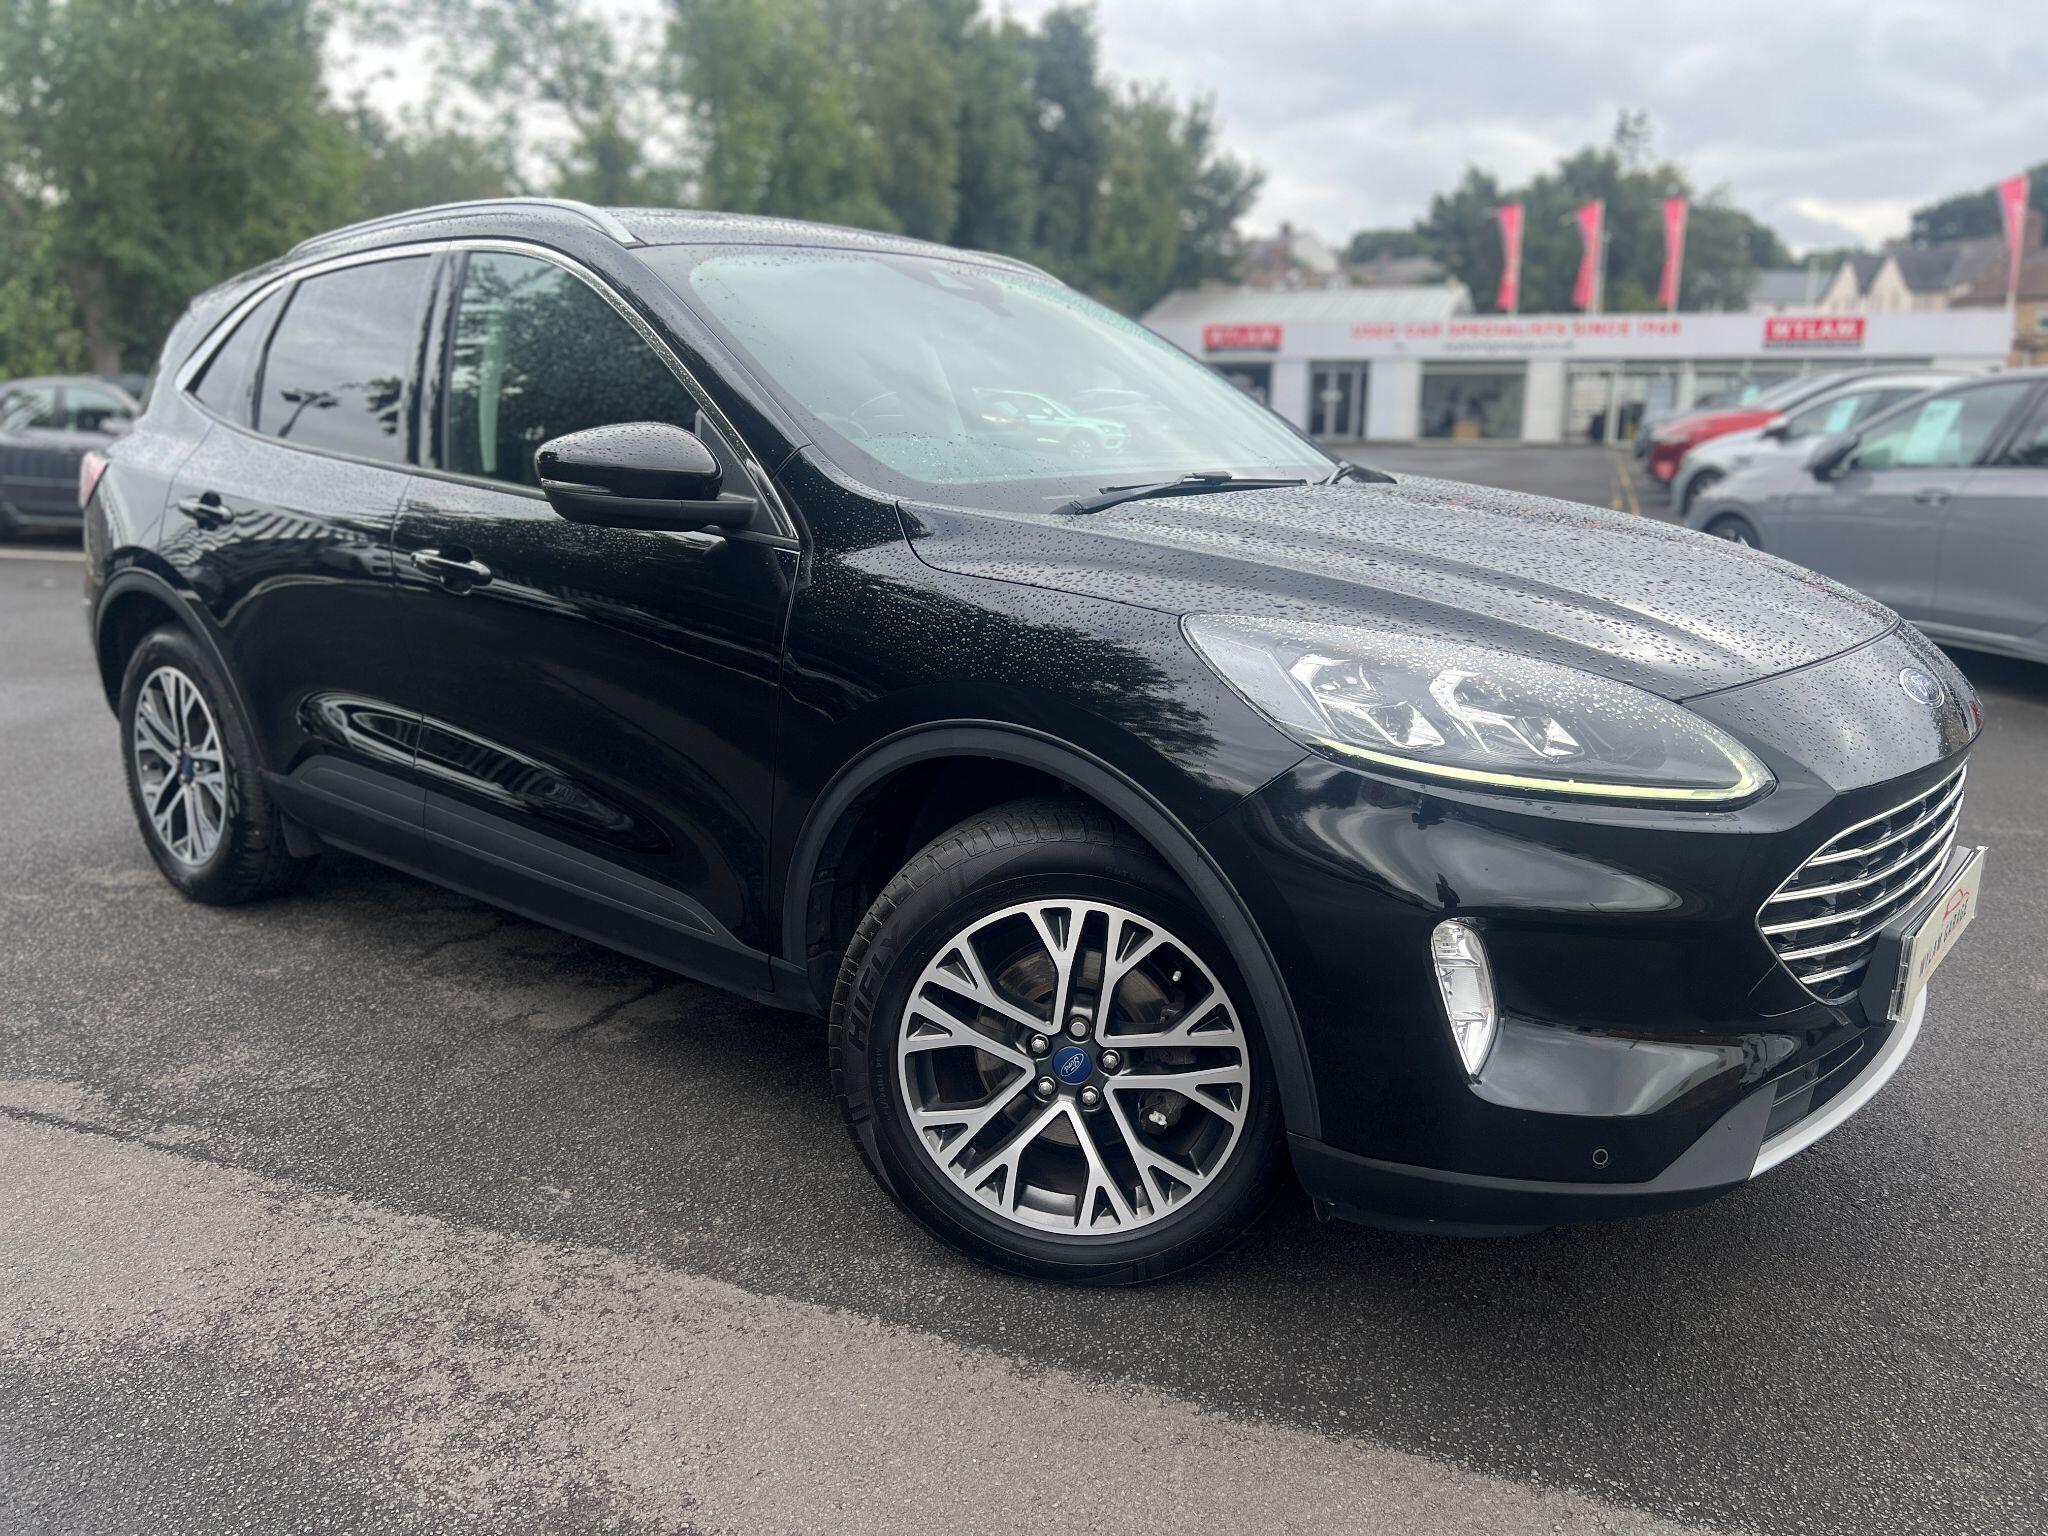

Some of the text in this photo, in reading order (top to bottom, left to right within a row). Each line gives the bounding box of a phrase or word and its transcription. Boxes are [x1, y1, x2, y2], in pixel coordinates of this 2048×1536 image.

[1352, 322, 1398, 338] USED
[1405, 322, 1443, 337] CAR
[1449, 321, 1567, 337] SPECIALISTS
[1573, 320, 1629, 336] SINCE
[1772, 321, 1857, 340] WYLAM
[1943, 897, 1969, 943] GARAGE
[1064, 1056, 1080, 1073] Ford
